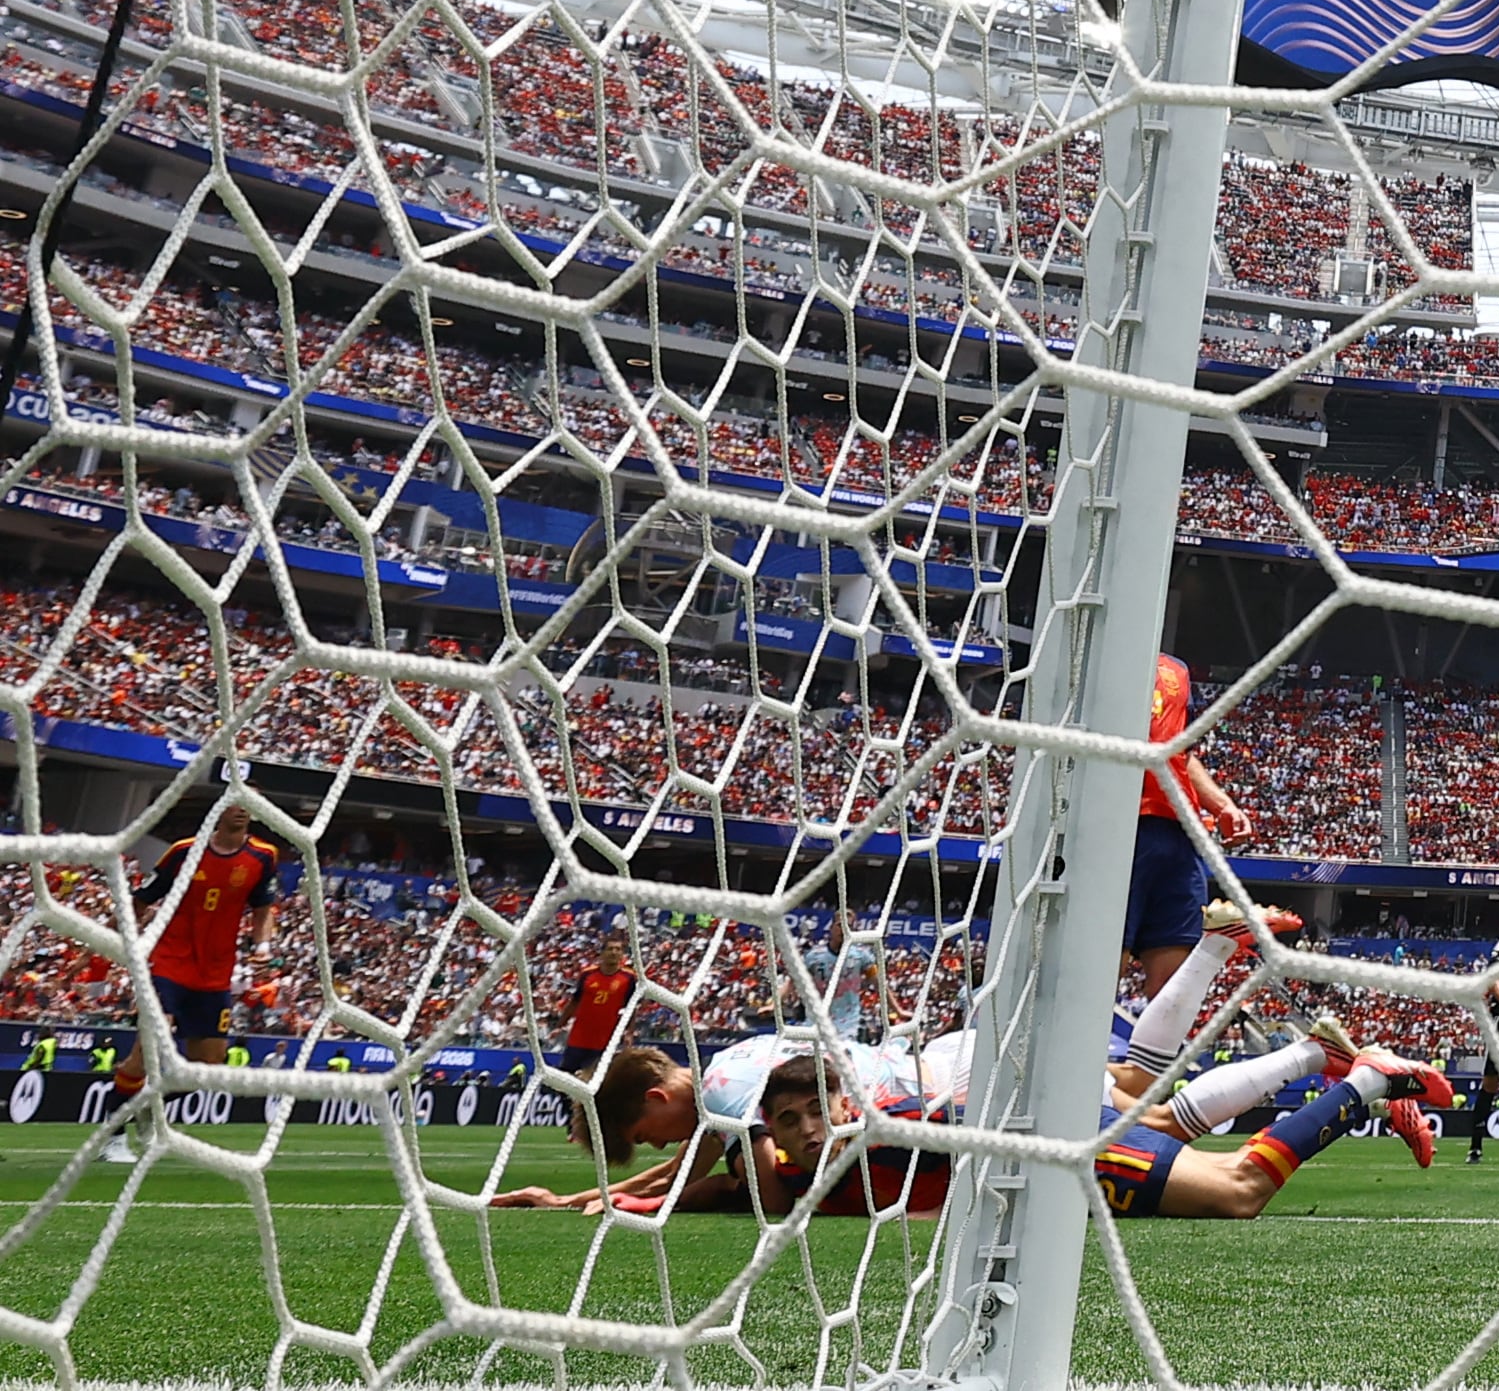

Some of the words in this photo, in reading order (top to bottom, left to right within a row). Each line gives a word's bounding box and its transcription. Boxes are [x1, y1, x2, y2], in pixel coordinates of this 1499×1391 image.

[603, 809, 613, 825] S
[1448, 872, 1456, 884] S
[203, 888, 221, 911] 8
[218, 1008, 231, 1032] 8
